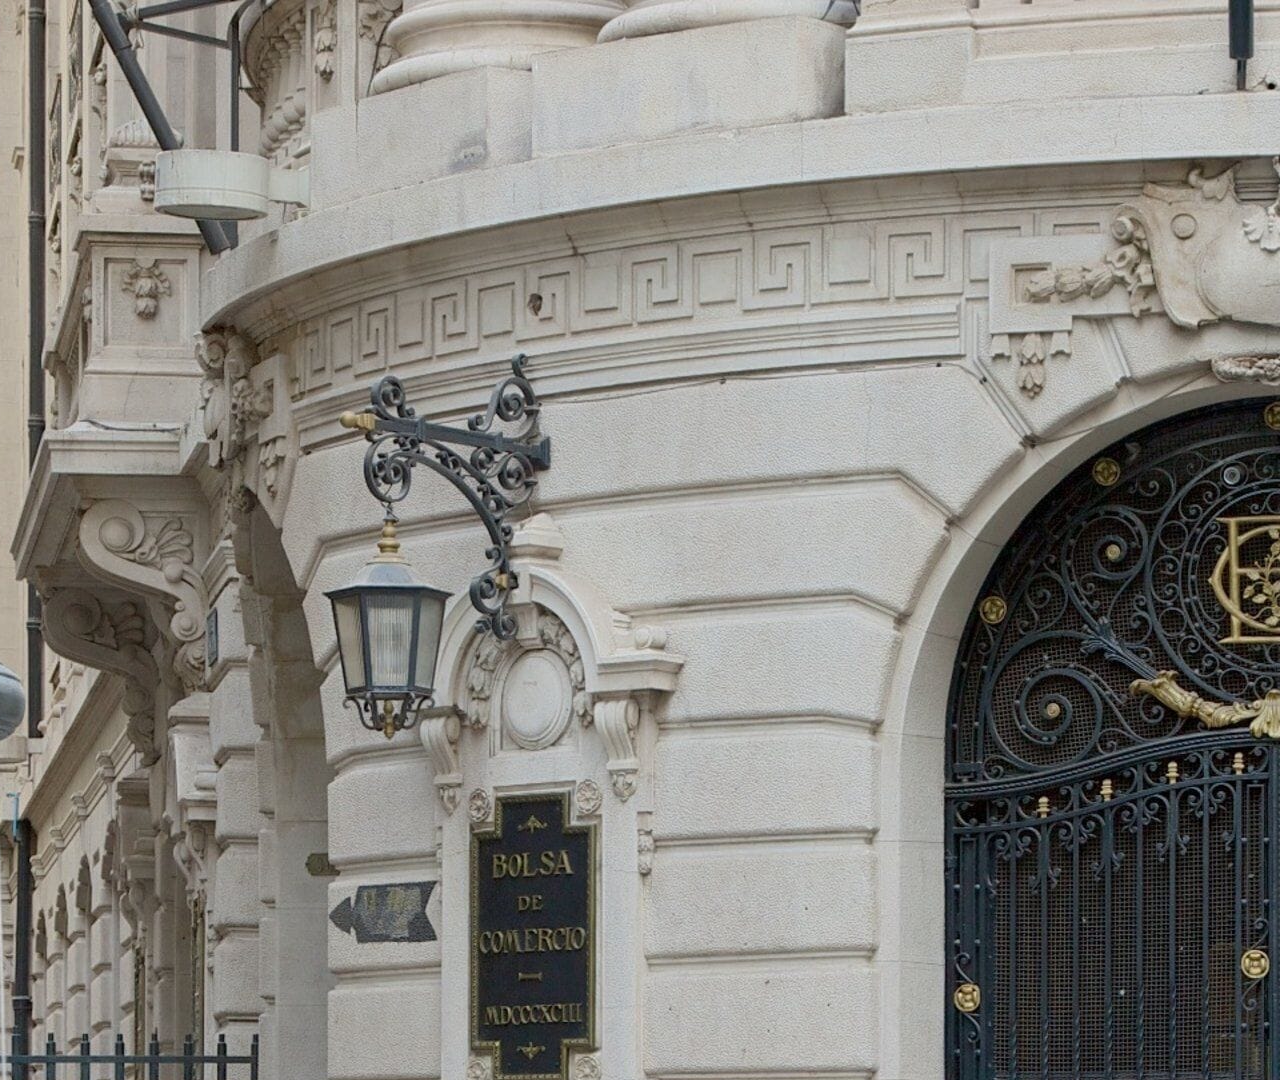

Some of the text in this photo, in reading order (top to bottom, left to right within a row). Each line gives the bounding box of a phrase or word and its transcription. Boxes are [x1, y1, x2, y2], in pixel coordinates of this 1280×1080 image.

[492, 849, 575, 878] BOLSA
[517, 894, 543, 911] DE
[480, 926, 586, 954] COMERCIO
[483, 1003, 583, 1025] MDCCCXCIII
